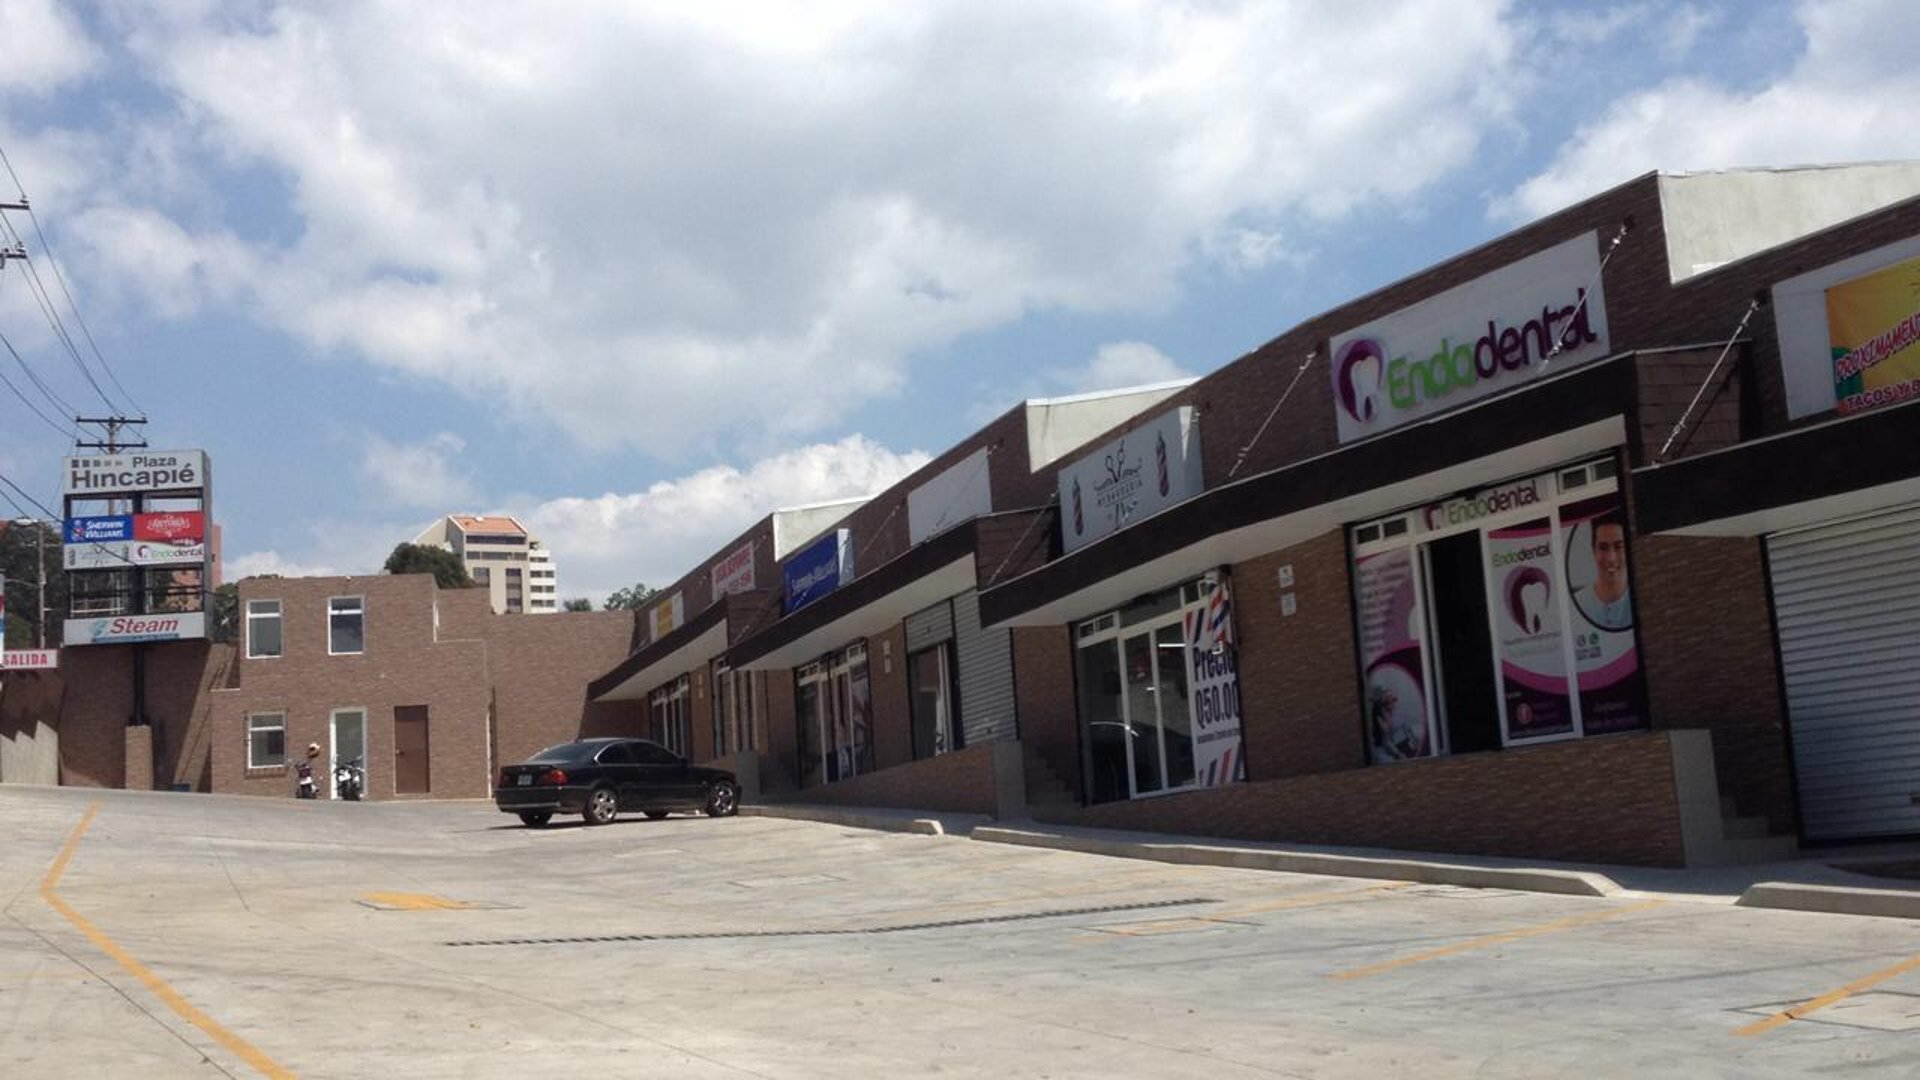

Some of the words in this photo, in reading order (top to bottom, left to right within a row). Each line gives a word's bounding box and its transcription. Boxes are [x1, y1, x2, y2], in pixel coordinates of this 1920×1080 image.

[1388, 287, 1597, 410] Endodental
[1848, 388, 1893, 409] TACOS
[132, 456, 177, 468] Plaza
[72, 463, 194, 489] Hincapié
[1450, 480, 1541, 525] Endodental
[110, 617, 178, 634] Steam
[2, 653, 48, 665] SALIDA
